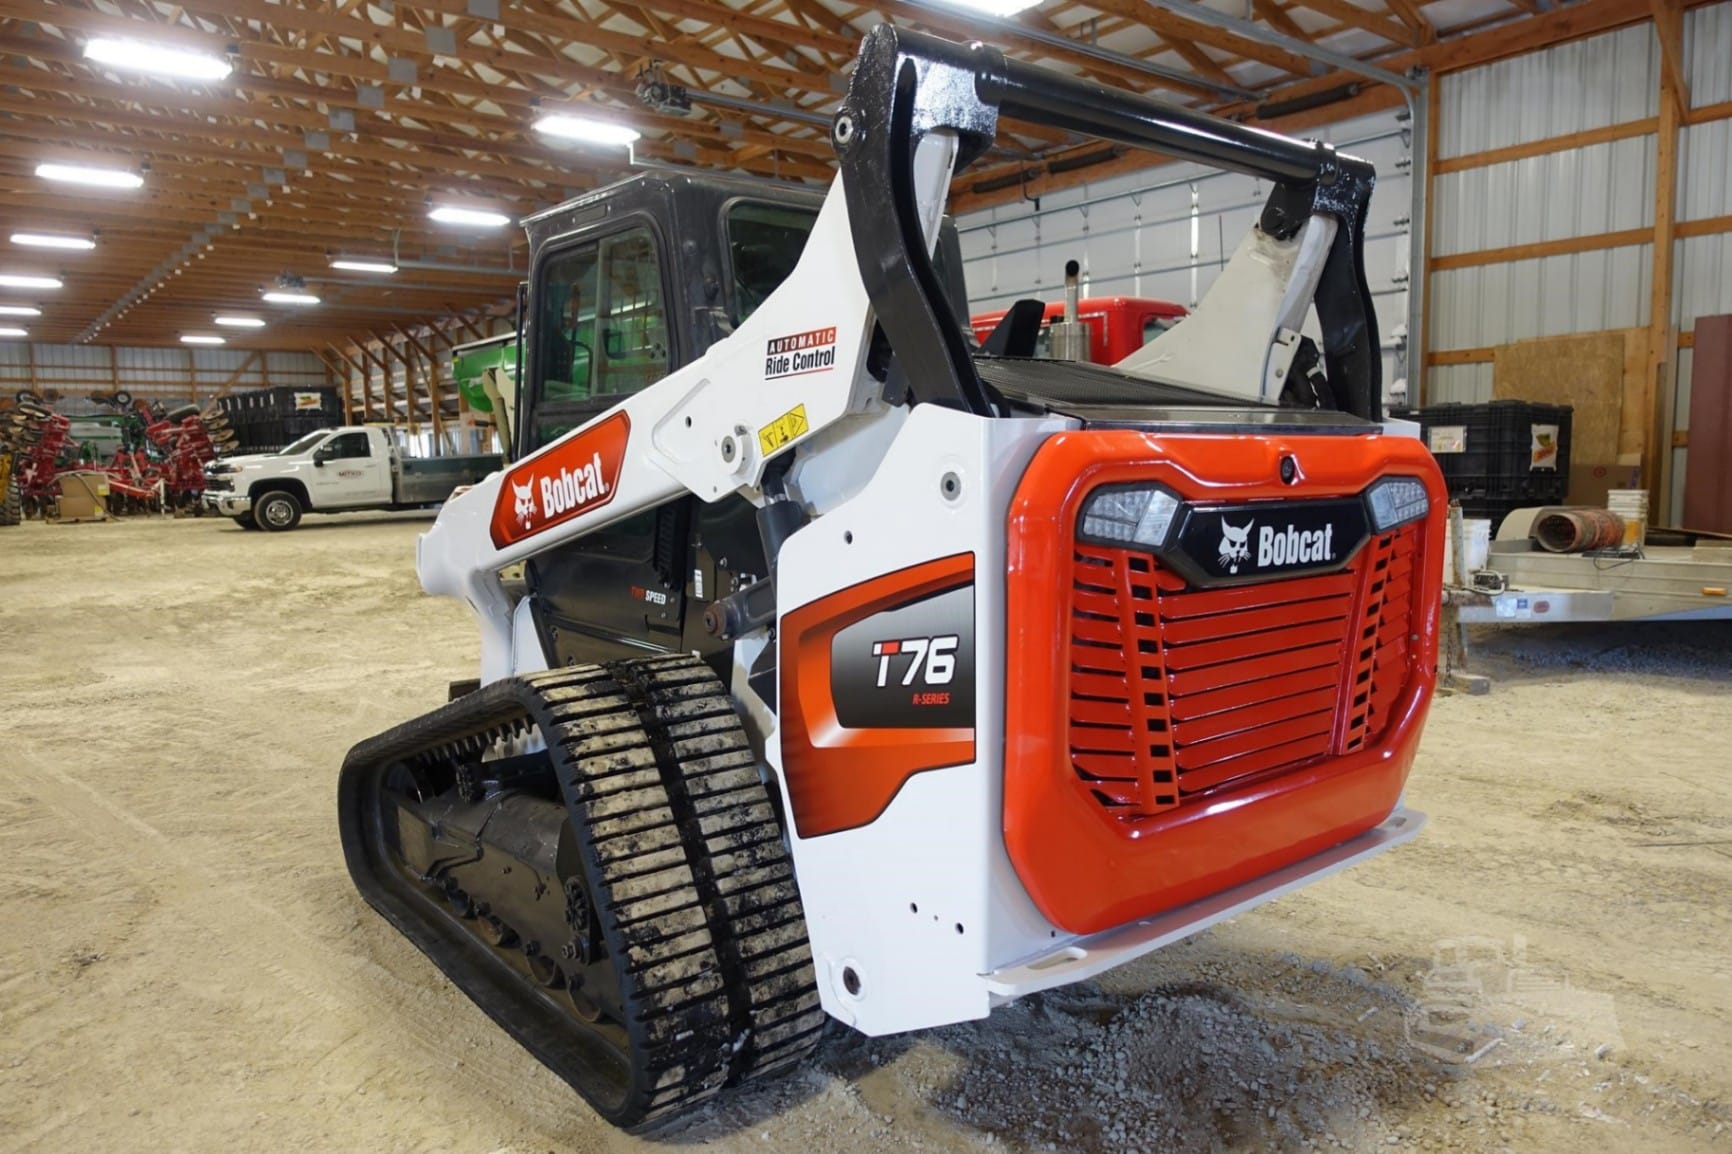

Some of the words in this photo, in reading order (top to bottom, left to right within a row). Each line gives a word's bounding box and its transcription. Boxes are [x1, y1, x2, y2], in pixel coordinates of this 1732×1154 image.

[768, 329, 835, 355] AUTOMATIC
[765, 355, 790, 376] Ride
[792, 345, 836, 371] Control
[540, 451, 606, 519] Bobcat
[1257, 523, 1333, 568] Bobcat
[645, 589, 667, 605] SPEED
[872, 635, 959, 688] T76
[912, 692, 950, 705] R-SERIES
